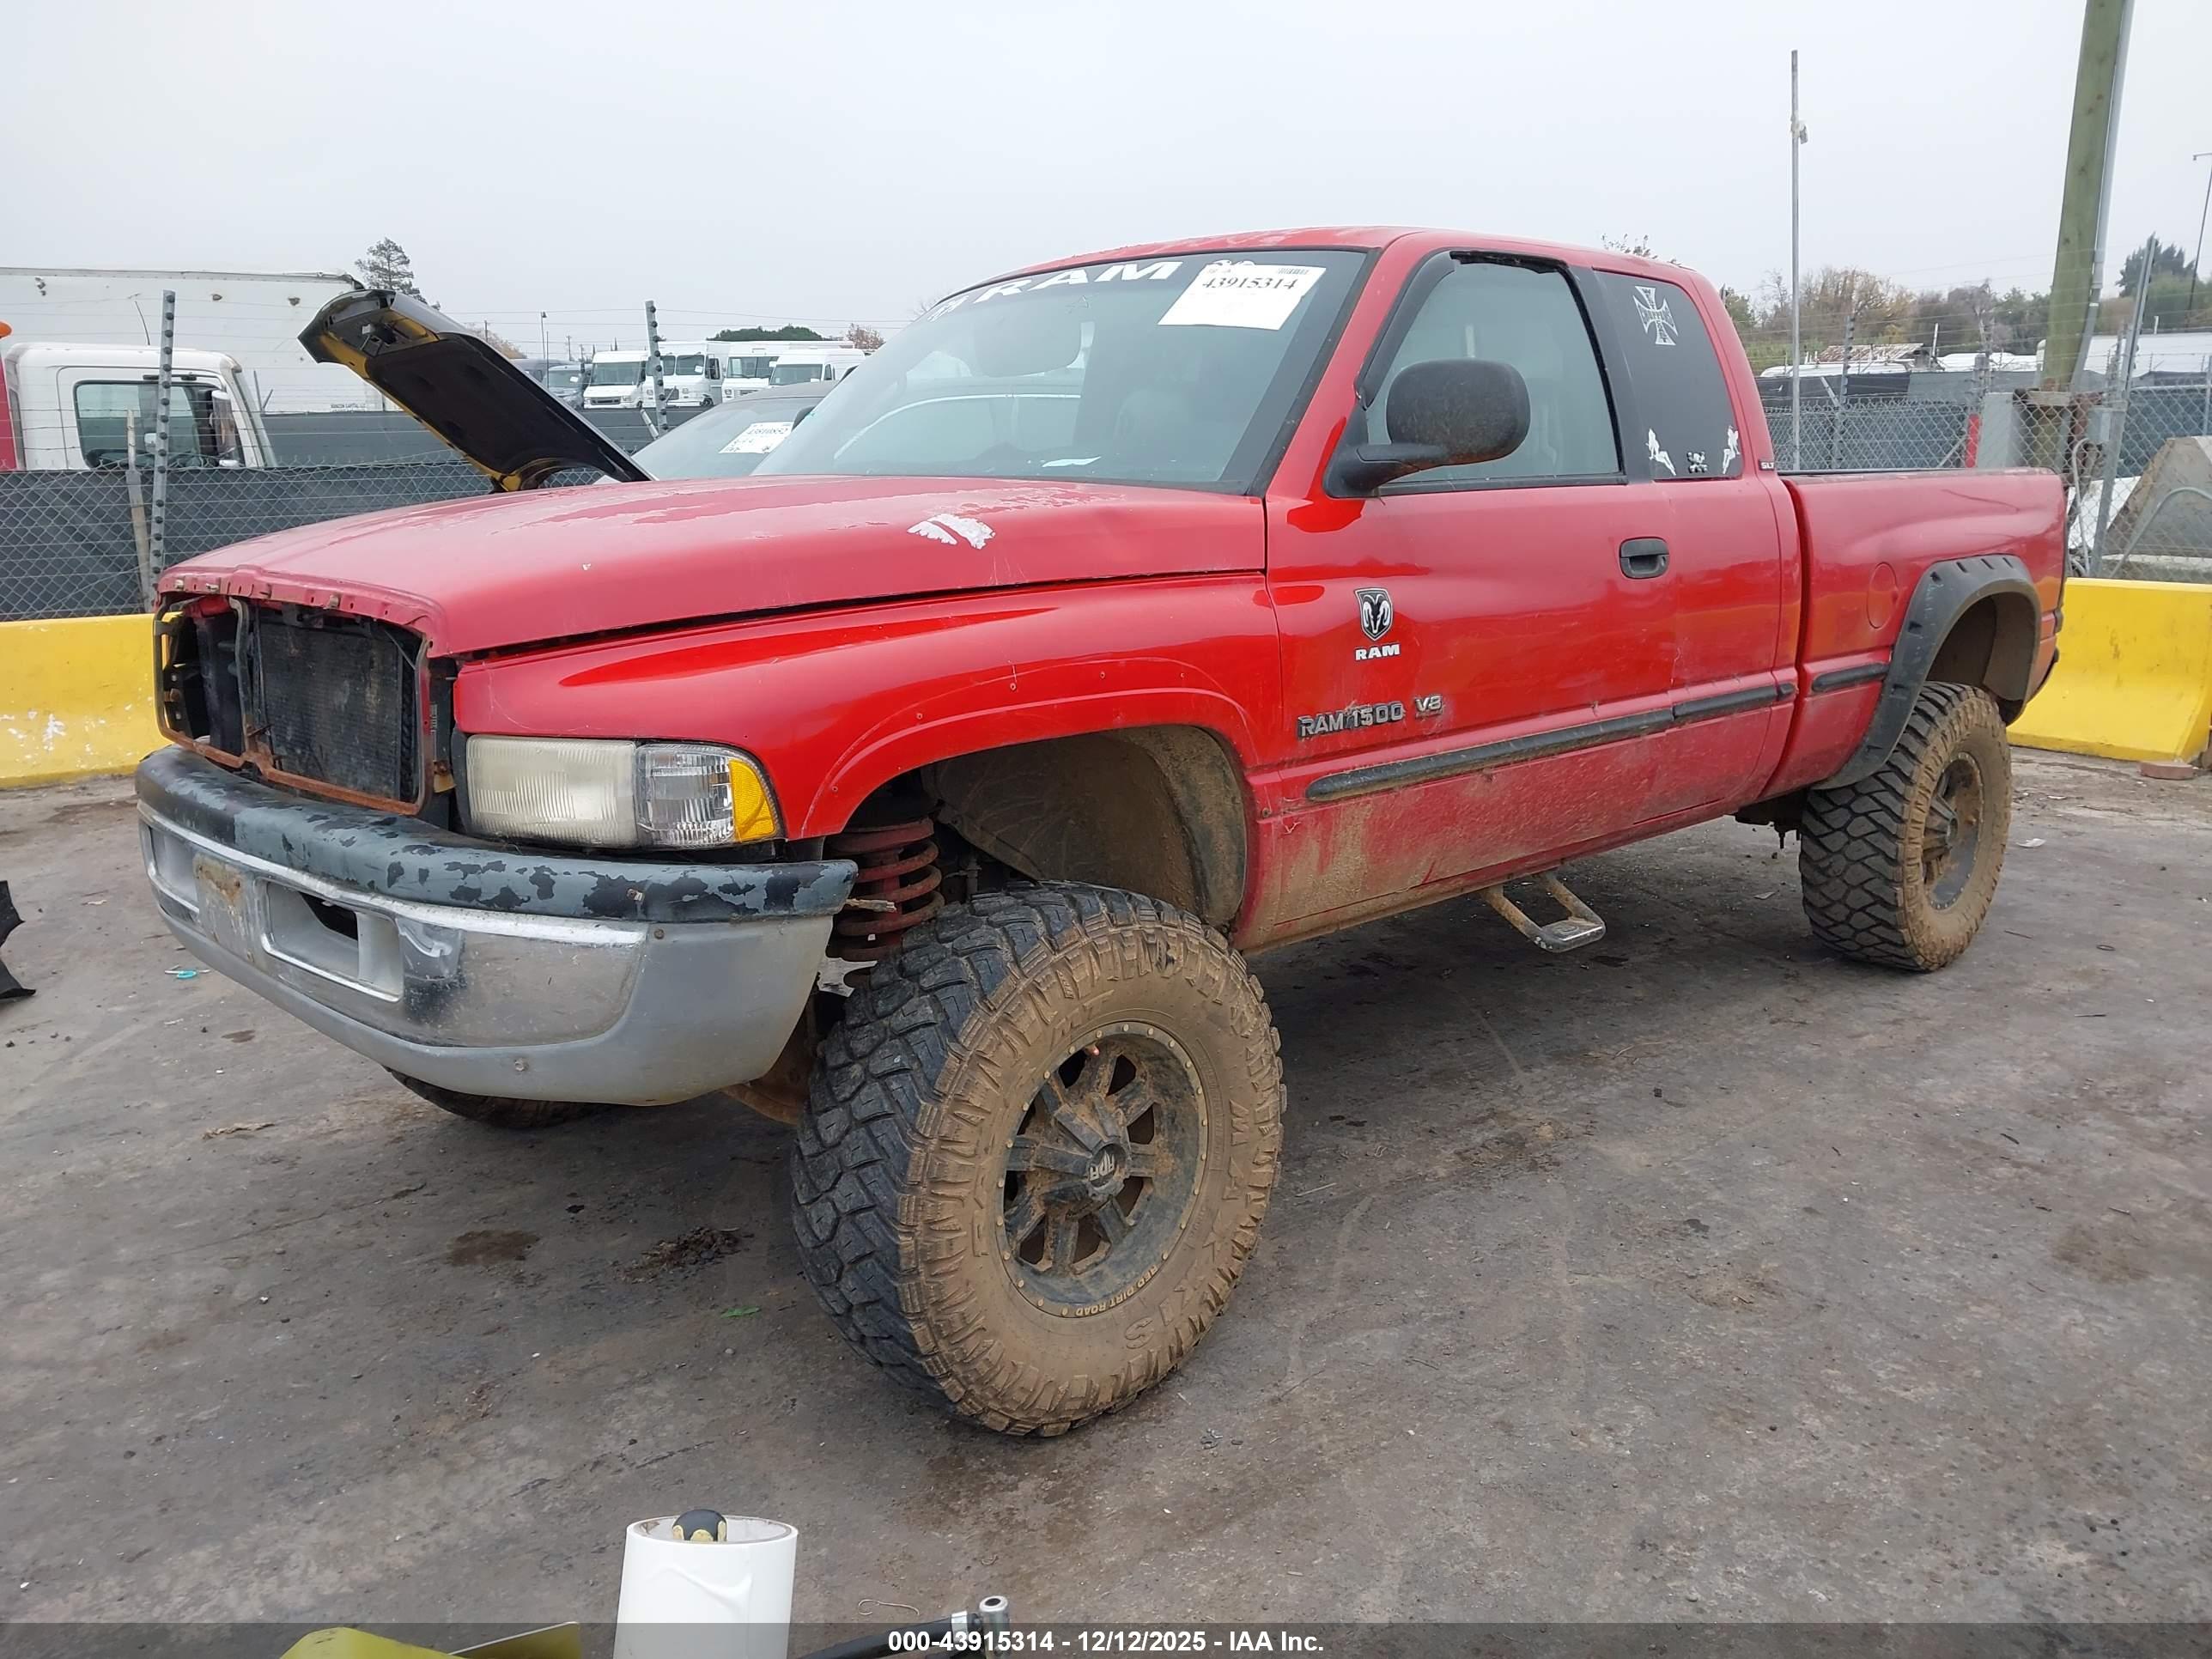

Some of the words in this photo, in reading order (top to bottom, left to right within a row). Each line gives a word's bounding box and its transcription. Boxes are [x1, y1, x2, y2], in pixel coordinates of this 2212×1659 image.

[974, 261, 1183, 304] RAM
[1203, 277, 1298, 289] 43915314
[1355, 644, 1401, 660] RAM
[1298, 712, 1345, 737] RAM
[1351, 702, 1403, 727] 1500
[1416, 695, 1443, 712] V8
[1137, 1264, 1158, 1288] RED
[1109, 1287, 1134, 1307] DIRT
[1075, 1302, 1106, 1317] ROAD
